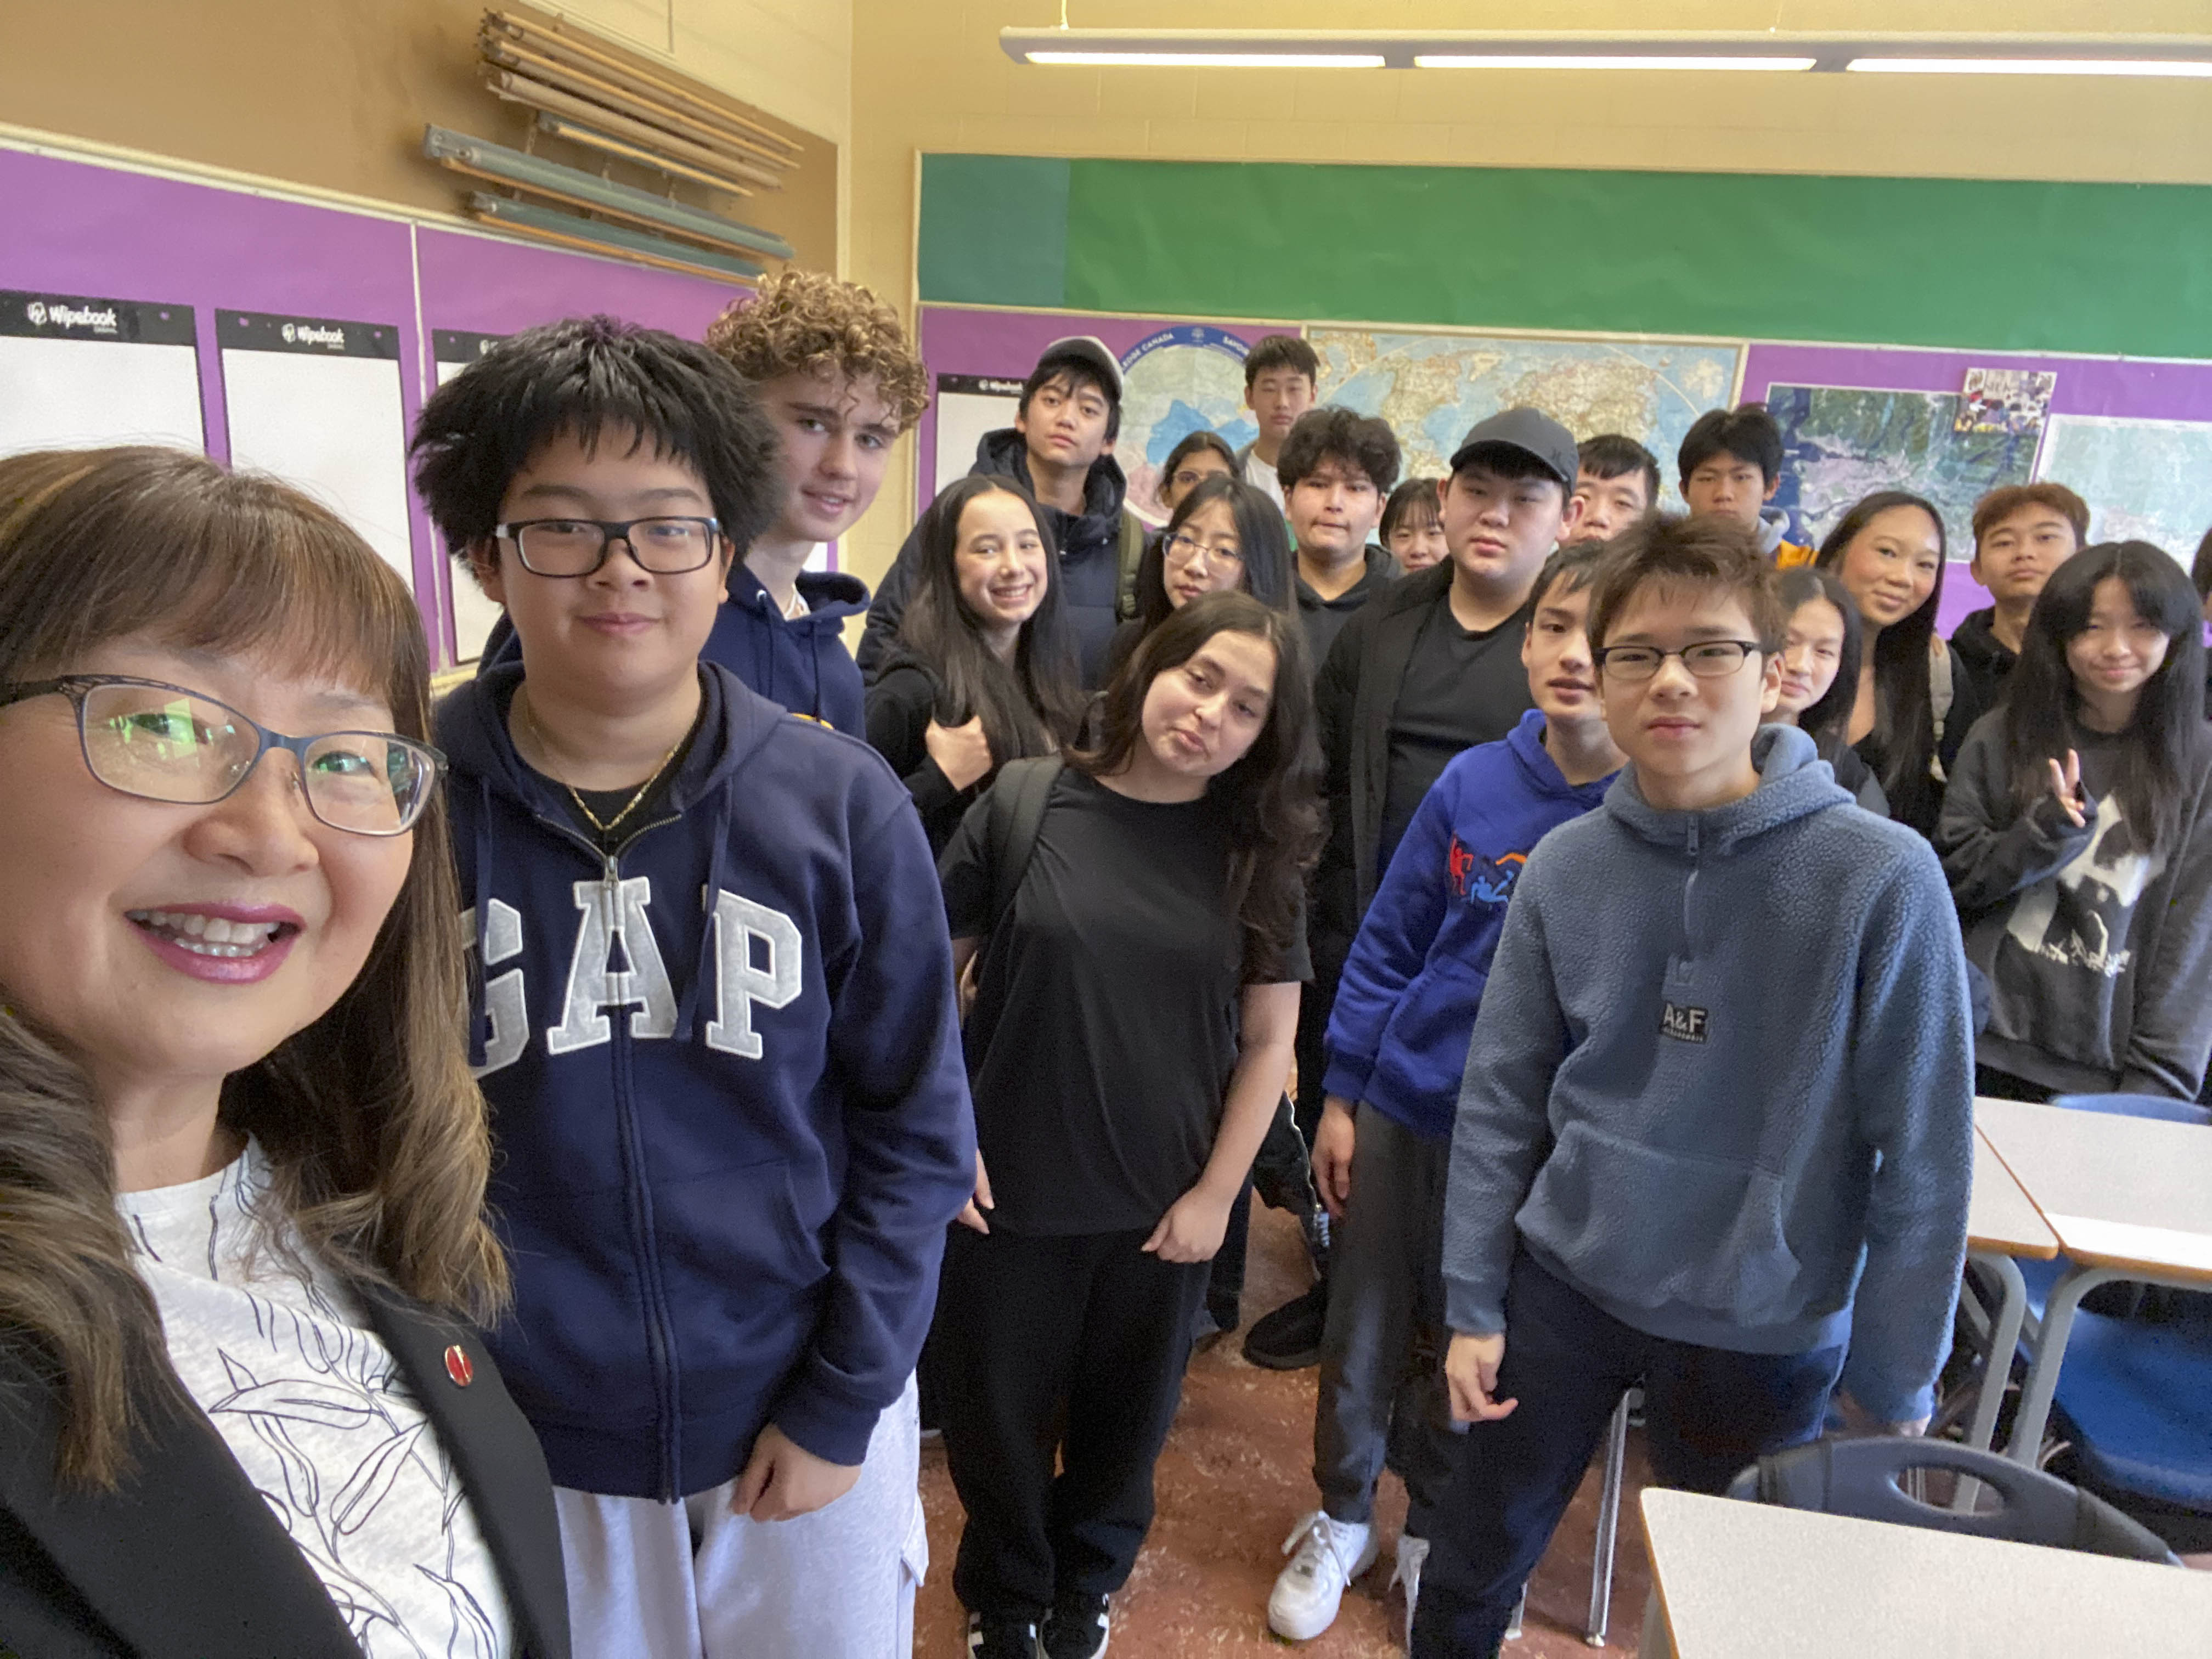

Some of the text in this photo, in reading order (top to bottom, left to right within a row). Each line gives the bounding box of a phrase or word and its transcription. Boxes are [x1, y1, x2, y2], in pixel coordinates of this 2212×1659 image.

[49, 304, 117, 329] Wipebook
[1141, 332, 1175, 351] CANADA
[460, 877, 802, 1079] GAP
[1663, 1003, 1705, 1033] A&F
